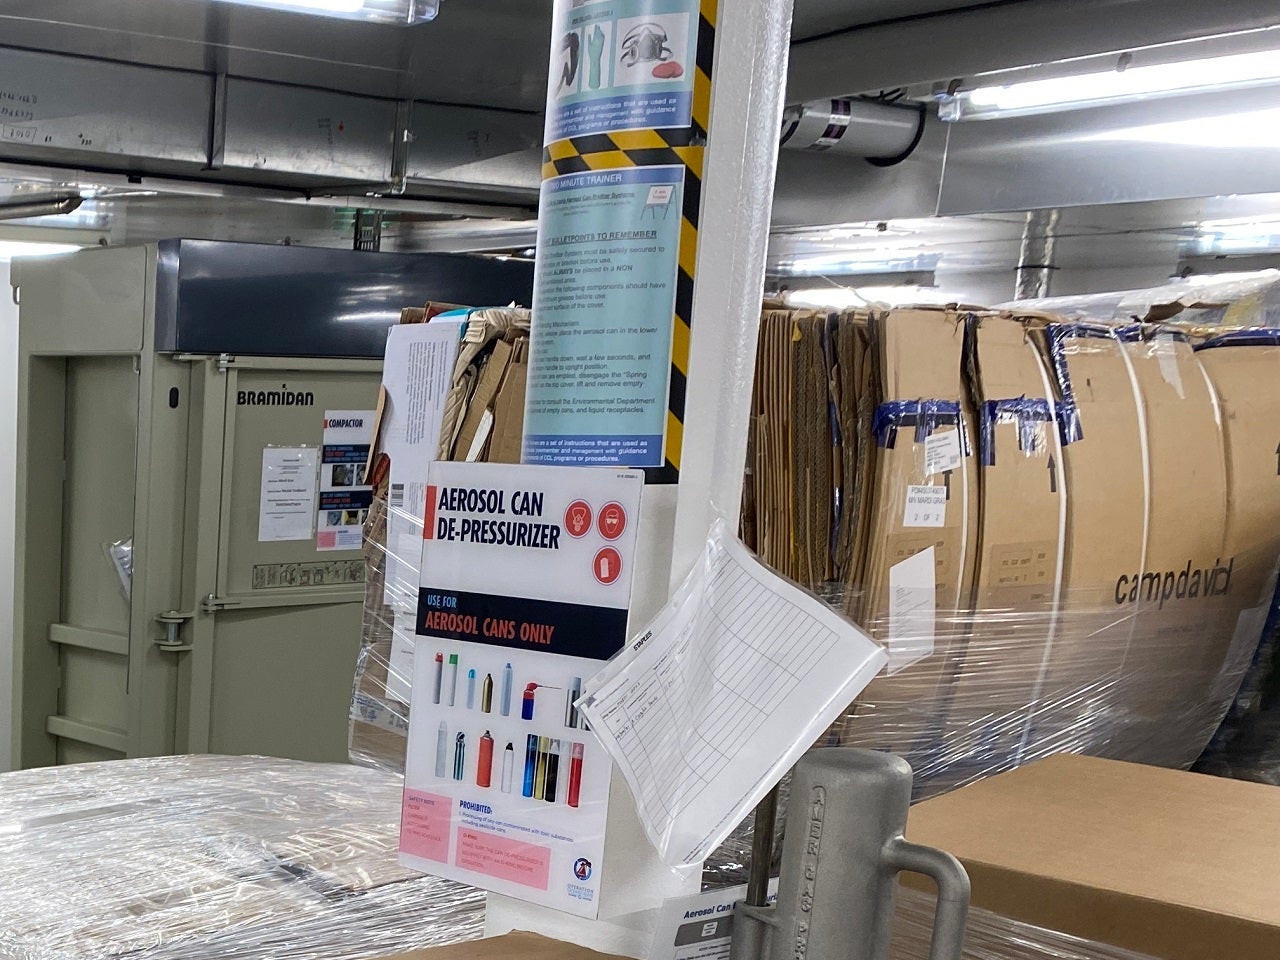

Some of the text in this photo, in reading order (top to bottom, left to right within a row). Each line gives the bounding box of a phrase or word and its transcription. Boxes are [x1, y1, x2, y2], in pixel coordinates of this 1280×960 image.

[646, 106, 676, 114] guidance
[561, 174, 622, 187] MINUTE TRAINER
[609, 231, 657, 239] REMEMBER
[586, 283, 624, 292] components
[329, 419, 363, 428] COMPACTOR
[438, 488, 544, 516] AEROSOL CAN
[437, 517, 561, 549] DE-PRESSURIZER
[1115, 557, 1234, 610] campdavid
[427, 595, 456, 608] USE FOR
[425, 611, 554, 645] AEROSOL CANS ONLY
[633, 631, 653, 651] STAPLES
[460, 800, 492, 814] PROHIBITED:
[684, 904, 730, 919] Aerosol Can
